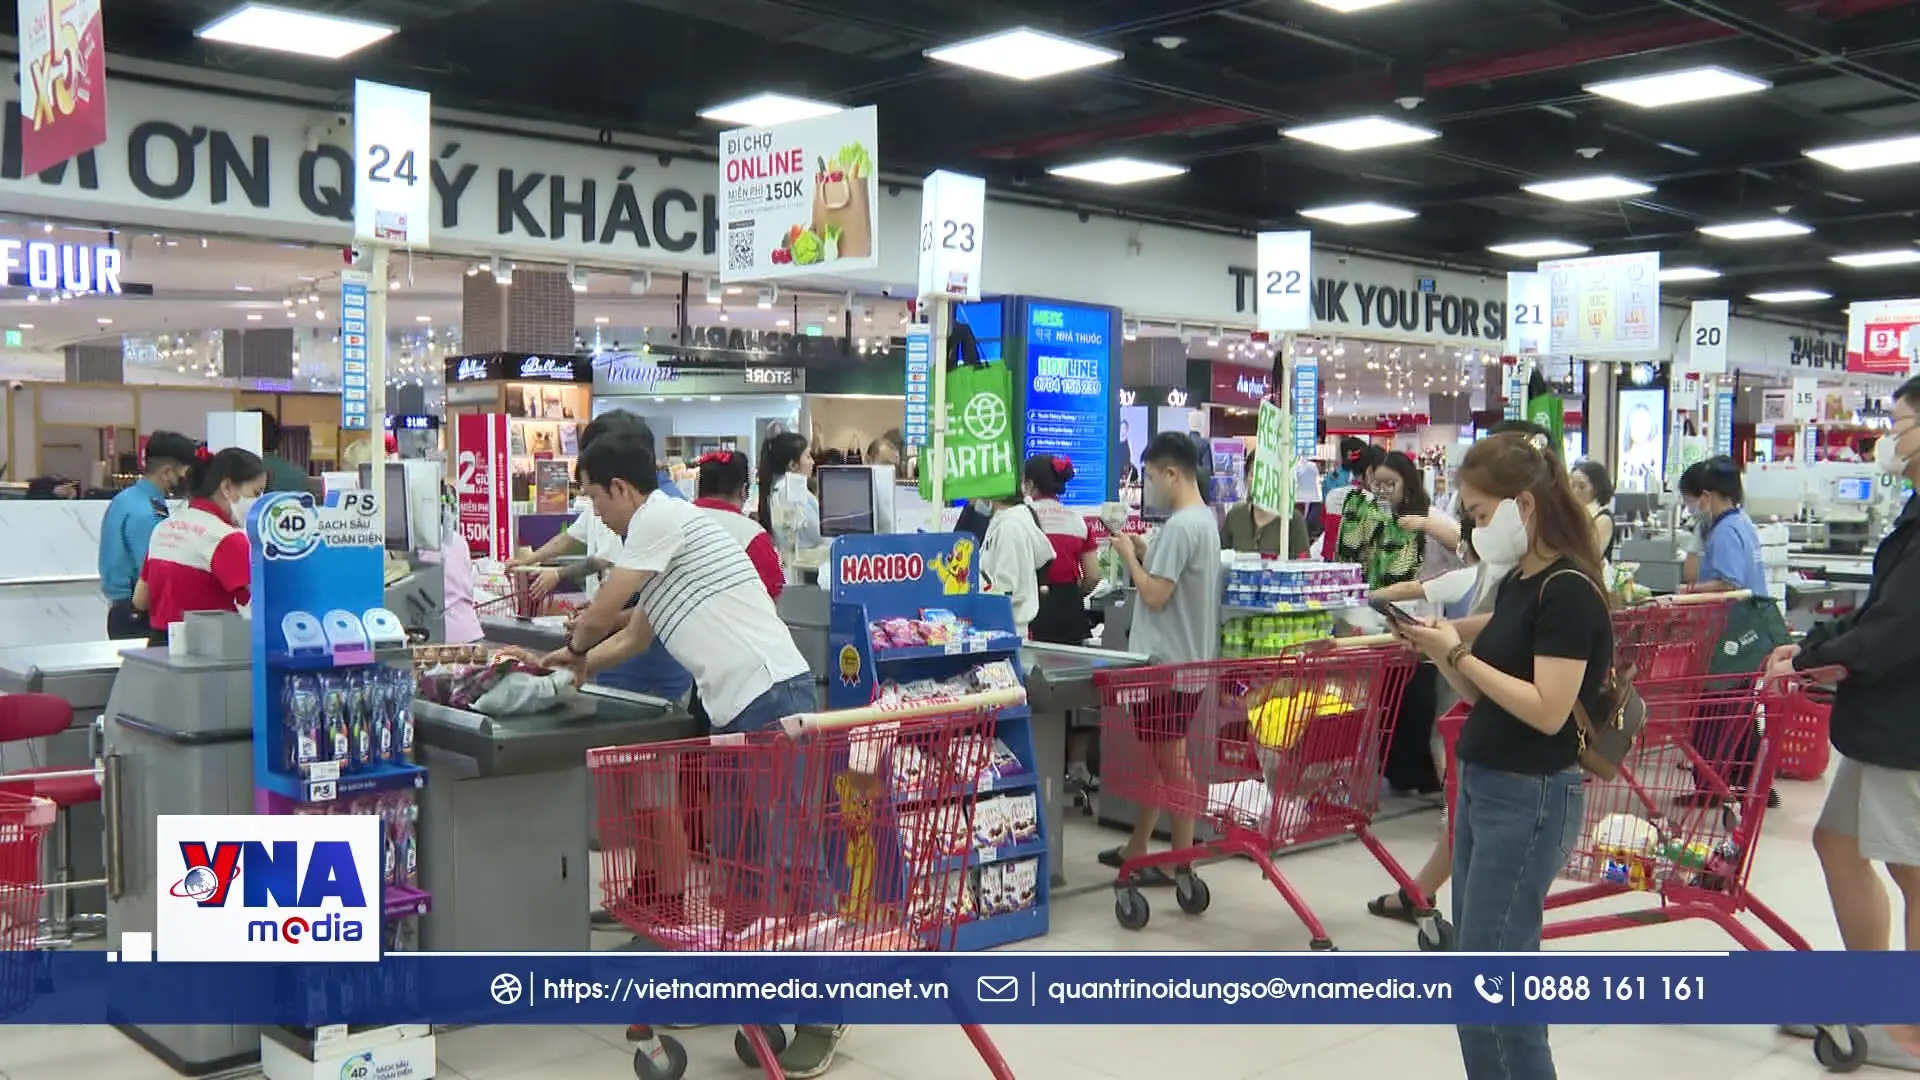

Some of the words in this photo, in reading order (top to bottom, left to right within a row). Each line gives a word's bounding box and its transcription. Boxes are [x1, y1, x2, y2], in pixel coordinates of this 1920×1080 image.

[128, 121, 270, 208] ƠN
[298, 142, 479, 229] QÝ
[368, 144, 418, 187] 24
[727, 148, 804, 183] ONLINE
[766, 179, 803, 201] 150K
[942, 219, 975, 253] 23
[1266, 270, 1301, 294] 22
[1228, 265, 1349, 323] TNK
[1354, 283, 1419, 332] YOU
[1424, 292, 1479, 338] FOR
[1515, 303, 1543, 325] 21
[1695, 327, 1721, 346] 20
[1037, 356, 1099, 379] HOTLINE
[279, 515, 306, 532] 4D
[840, 552, 925, 585] HARIBO
